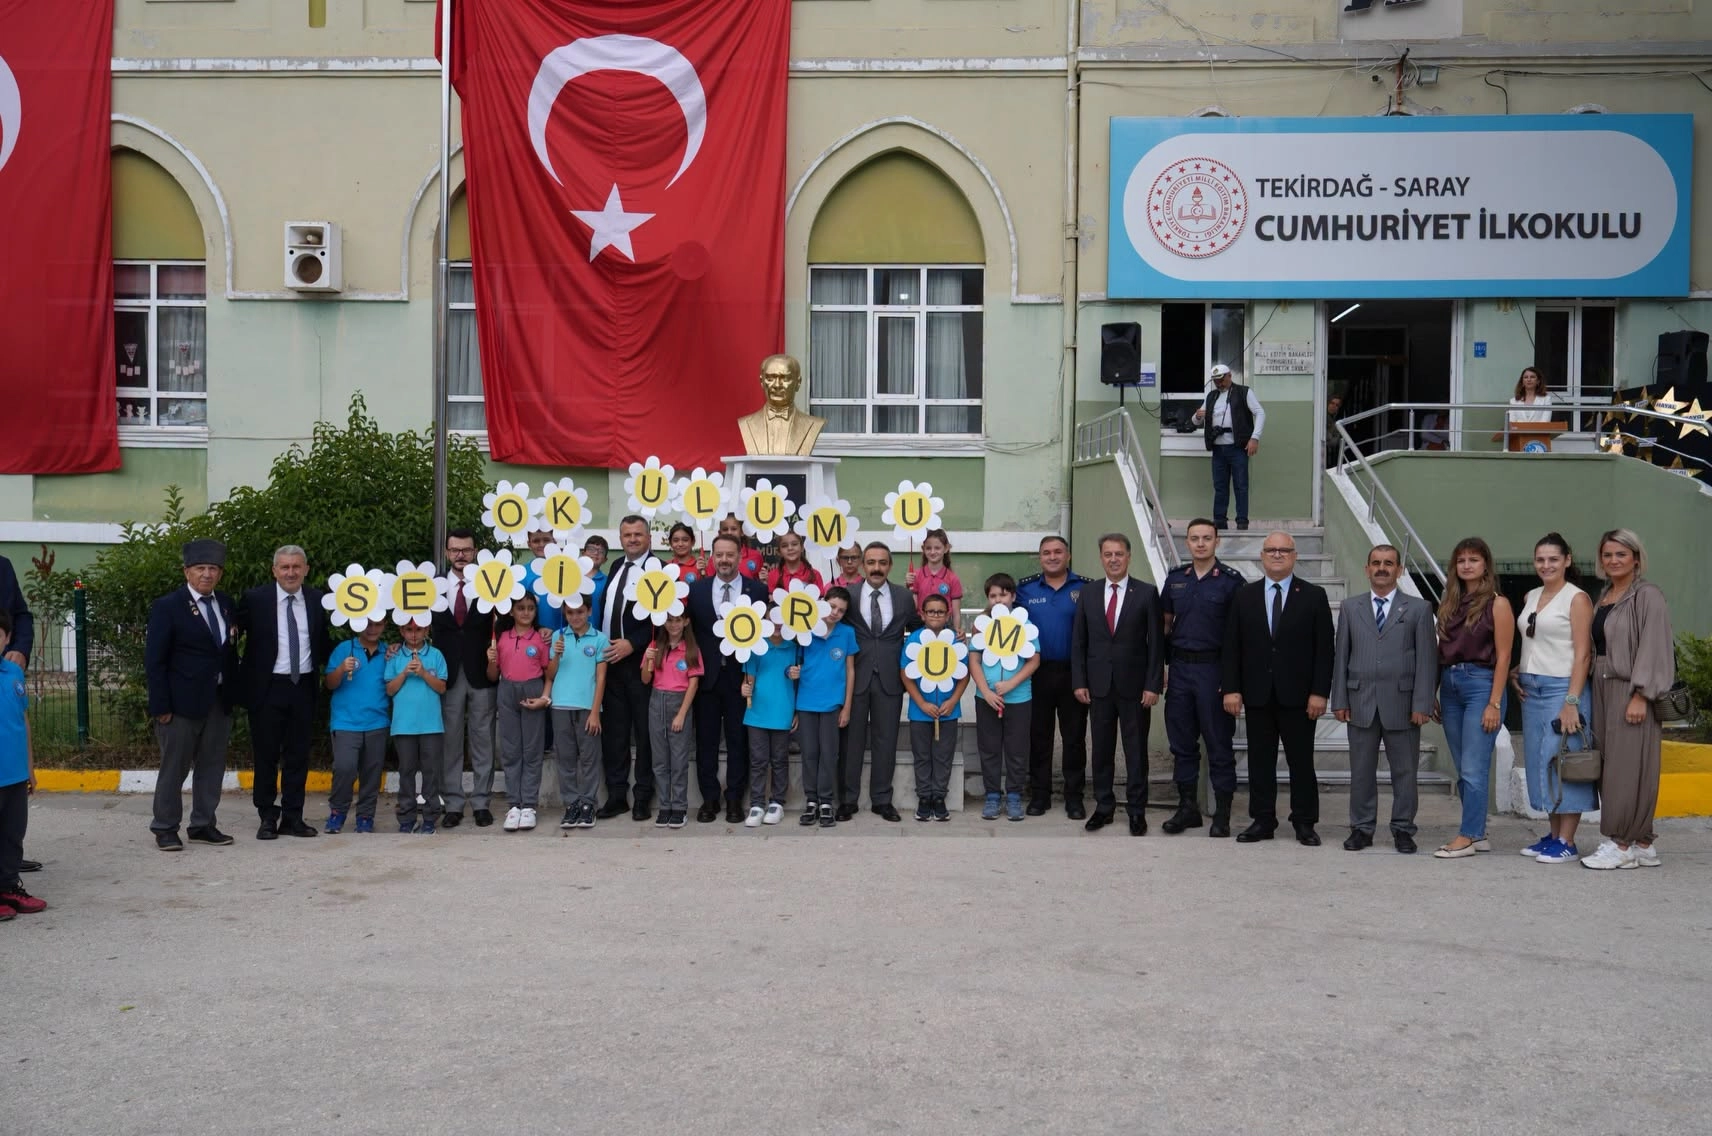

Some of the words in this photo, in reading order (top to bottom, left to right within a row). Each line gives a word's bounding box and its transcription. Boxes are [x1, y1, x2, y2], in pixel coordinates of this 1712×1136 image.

[1256, 172, 1373, 198] TEKİRDAĞ
[1393, 176, 1471, 198] SARAY
[1254, 207, 1472, 242] CUMHURİYET
[1478, 206, 1642, 240] İLKOKULU
